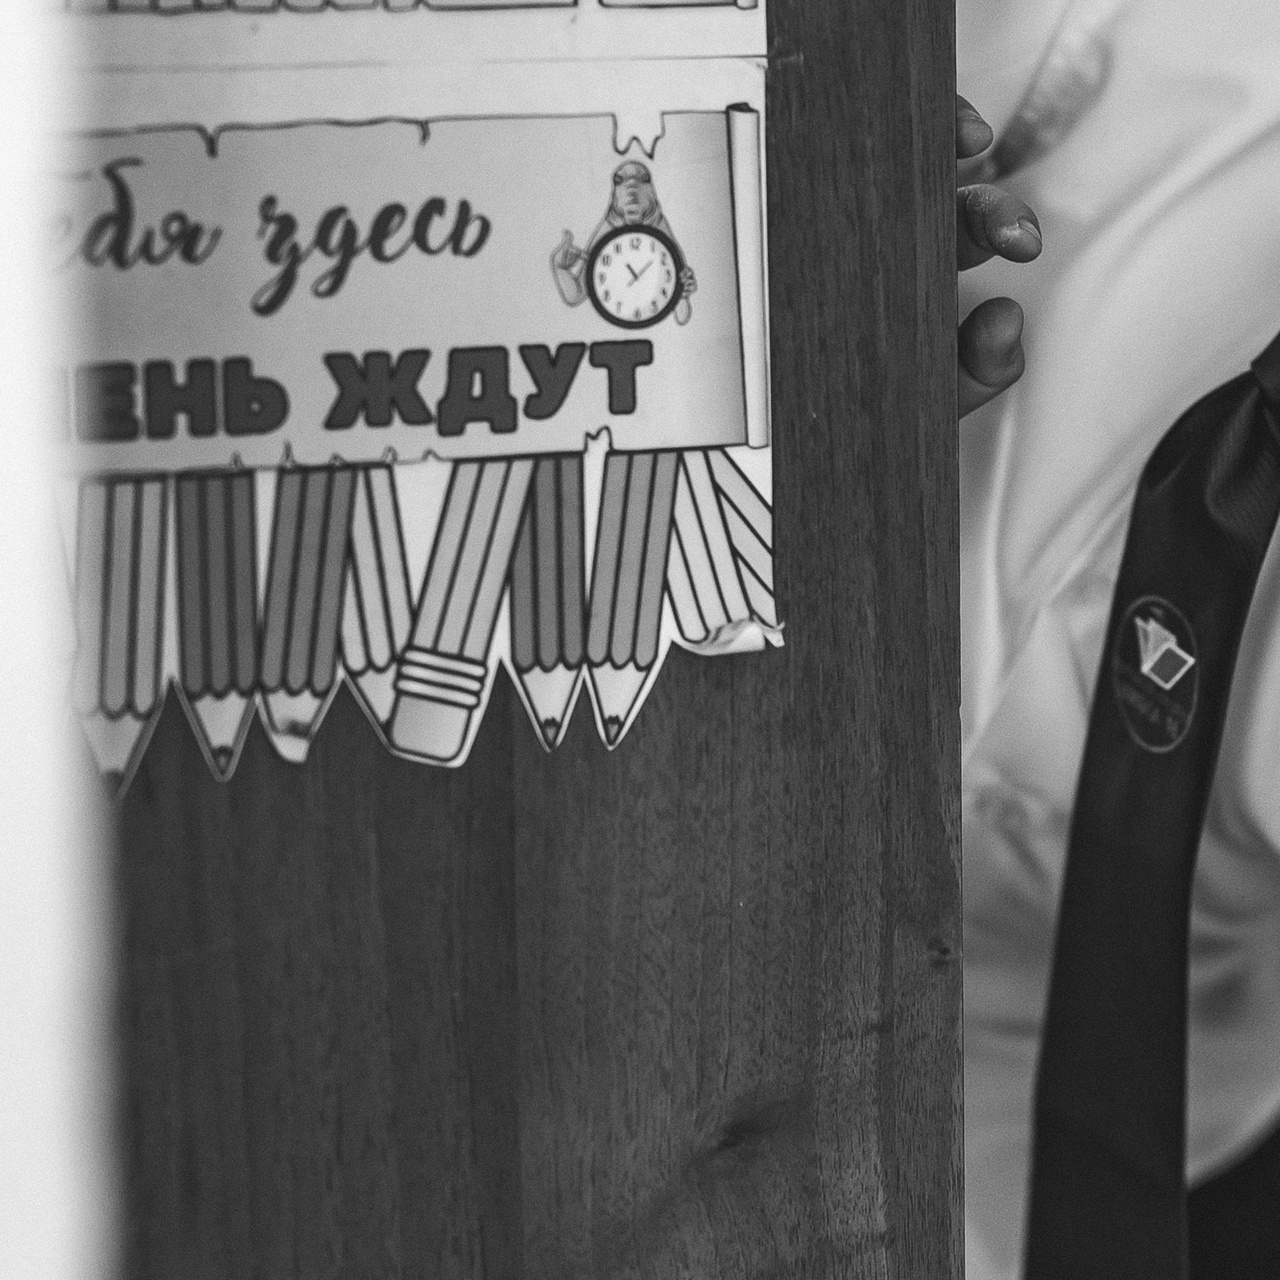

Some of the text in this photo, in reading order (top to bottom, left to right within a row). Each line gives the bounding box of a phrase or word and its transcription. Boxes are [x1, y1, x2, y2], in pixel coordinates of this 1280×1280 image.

[60, 156, 492, 318] бя здесь
[70, 339, 655, 445] ЕНЬ ЖДУТ
